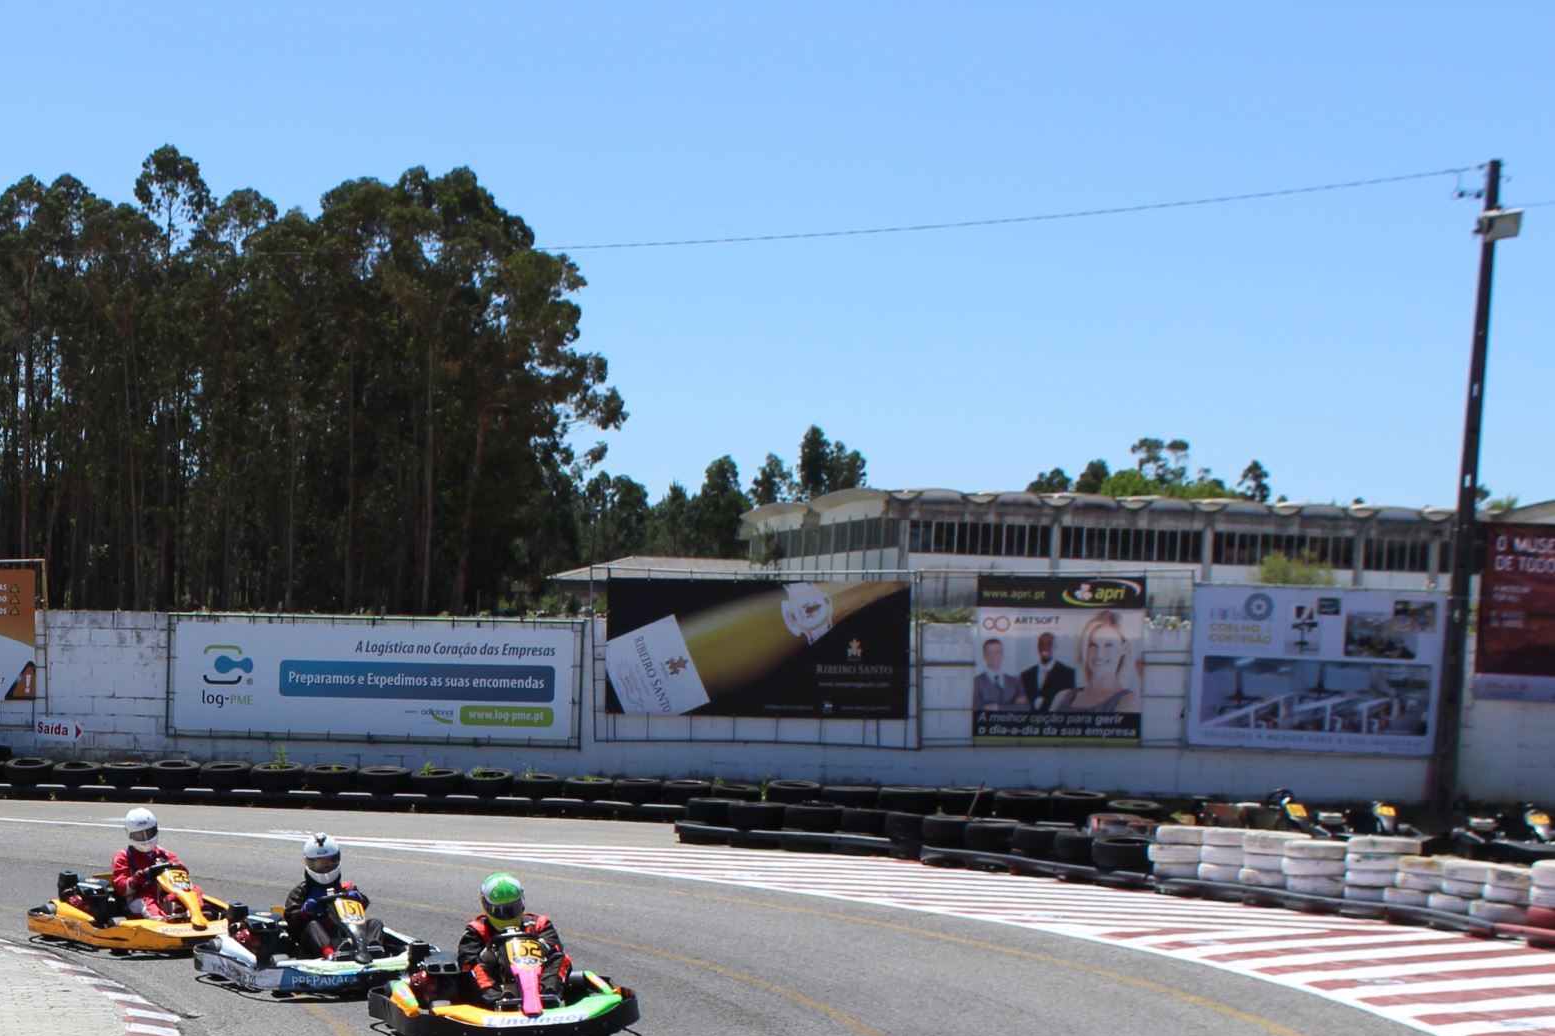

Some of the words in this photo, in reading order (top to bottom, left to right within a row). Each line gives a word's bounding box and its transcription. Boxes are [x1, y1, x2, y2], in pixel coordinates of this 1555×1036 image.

[1496, 556, 1515, 571] DE
[982, 590, 1046, 600] www.apri.pt
[1095, 586, 1126, 602] apri
[1014, 616, 1060, 624] ARTSOFT
[355, 642, 363, 653] A
[366, 640, 415, 657] Logística
[416, 645, 430, 655] no
[433, 643, 476, 659] Coração
[480, 645, 499, 656] das
[502, 646, 556, 661] Empresas
[634, 635, 656, 680] RIBEIRO
[858, 663, 893, 675] SANTO
[288, 671, 355, 689] Preparamos
[358, 677, 365, 685] e
[367, 673, 428, 690] Expedimos
[430, 678, 443, 687] as
[445, 678, 470, 688] suas
[473, 675, 545, 690] encomendas
[469, 709, 544, 723] www.log-pme.pt
[978, 713, 986, 722] A
[989, 713, 1026, 723] melhor
[1030, 713, 1064, 726] opção
[1067, 714, 1091, 726] para
[1095, 715, 1123, 726] gerir
[37, 721, 68, 736] Saída
[989, 726, 1039, 735] dia-a-dia
[1043, 727, 1057, 735] da
[1060, 728, 1081, 736] sua
[1085, 728, 1136, 739] empresa
[486, 1013, 589, 1027] Lindinger
